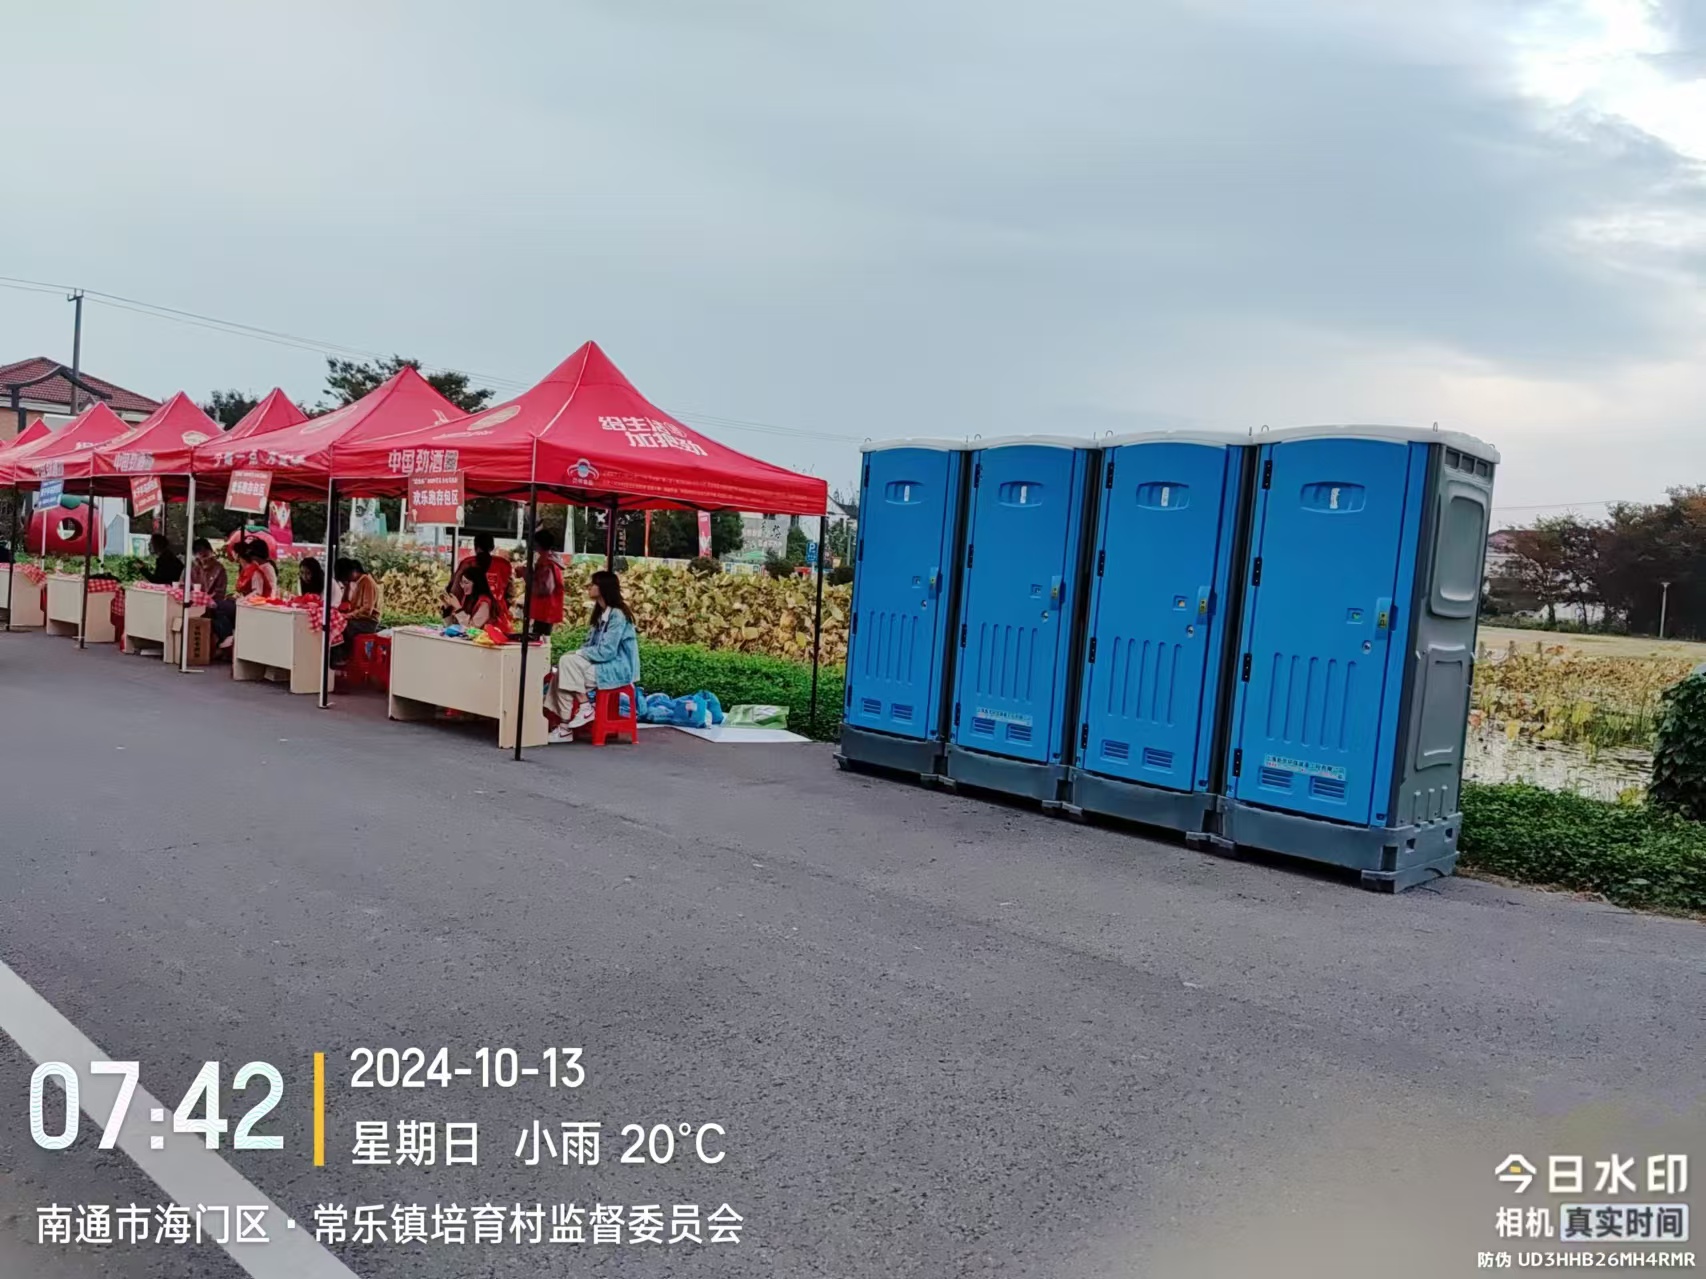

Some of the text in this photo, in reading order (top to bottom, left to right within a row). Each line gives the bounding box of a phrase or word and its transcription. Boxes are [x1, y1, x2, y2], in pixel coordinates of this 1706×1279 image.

[388, 449, 445, 473] 中国劲酒
[412, 489, 459, 506] 欢乐跑存包区
